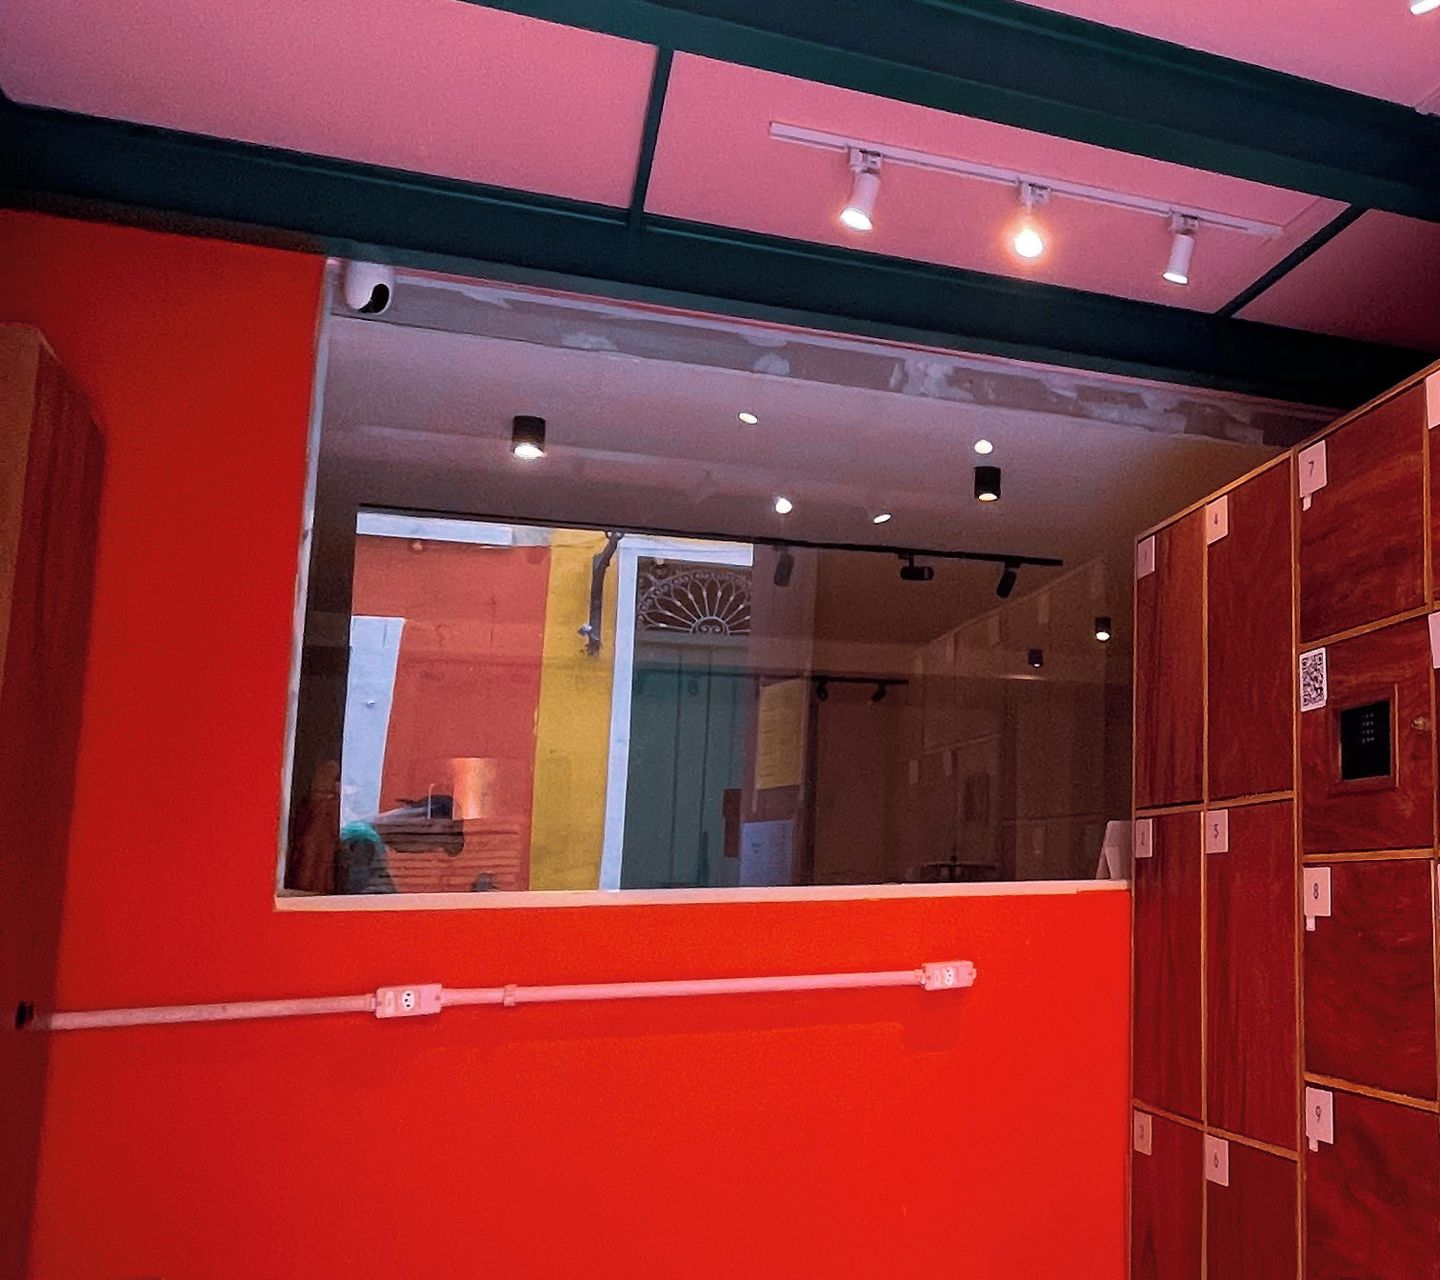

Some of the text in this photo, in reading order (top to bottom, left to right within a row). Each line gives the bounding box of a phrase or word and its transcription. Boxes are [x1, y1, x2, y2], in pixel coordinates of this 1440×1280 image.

[1308, 461, 1314, 477] 7
[1314, 883, 1319, 900] 8
[1315, 1106, 1321, 1123] 9
